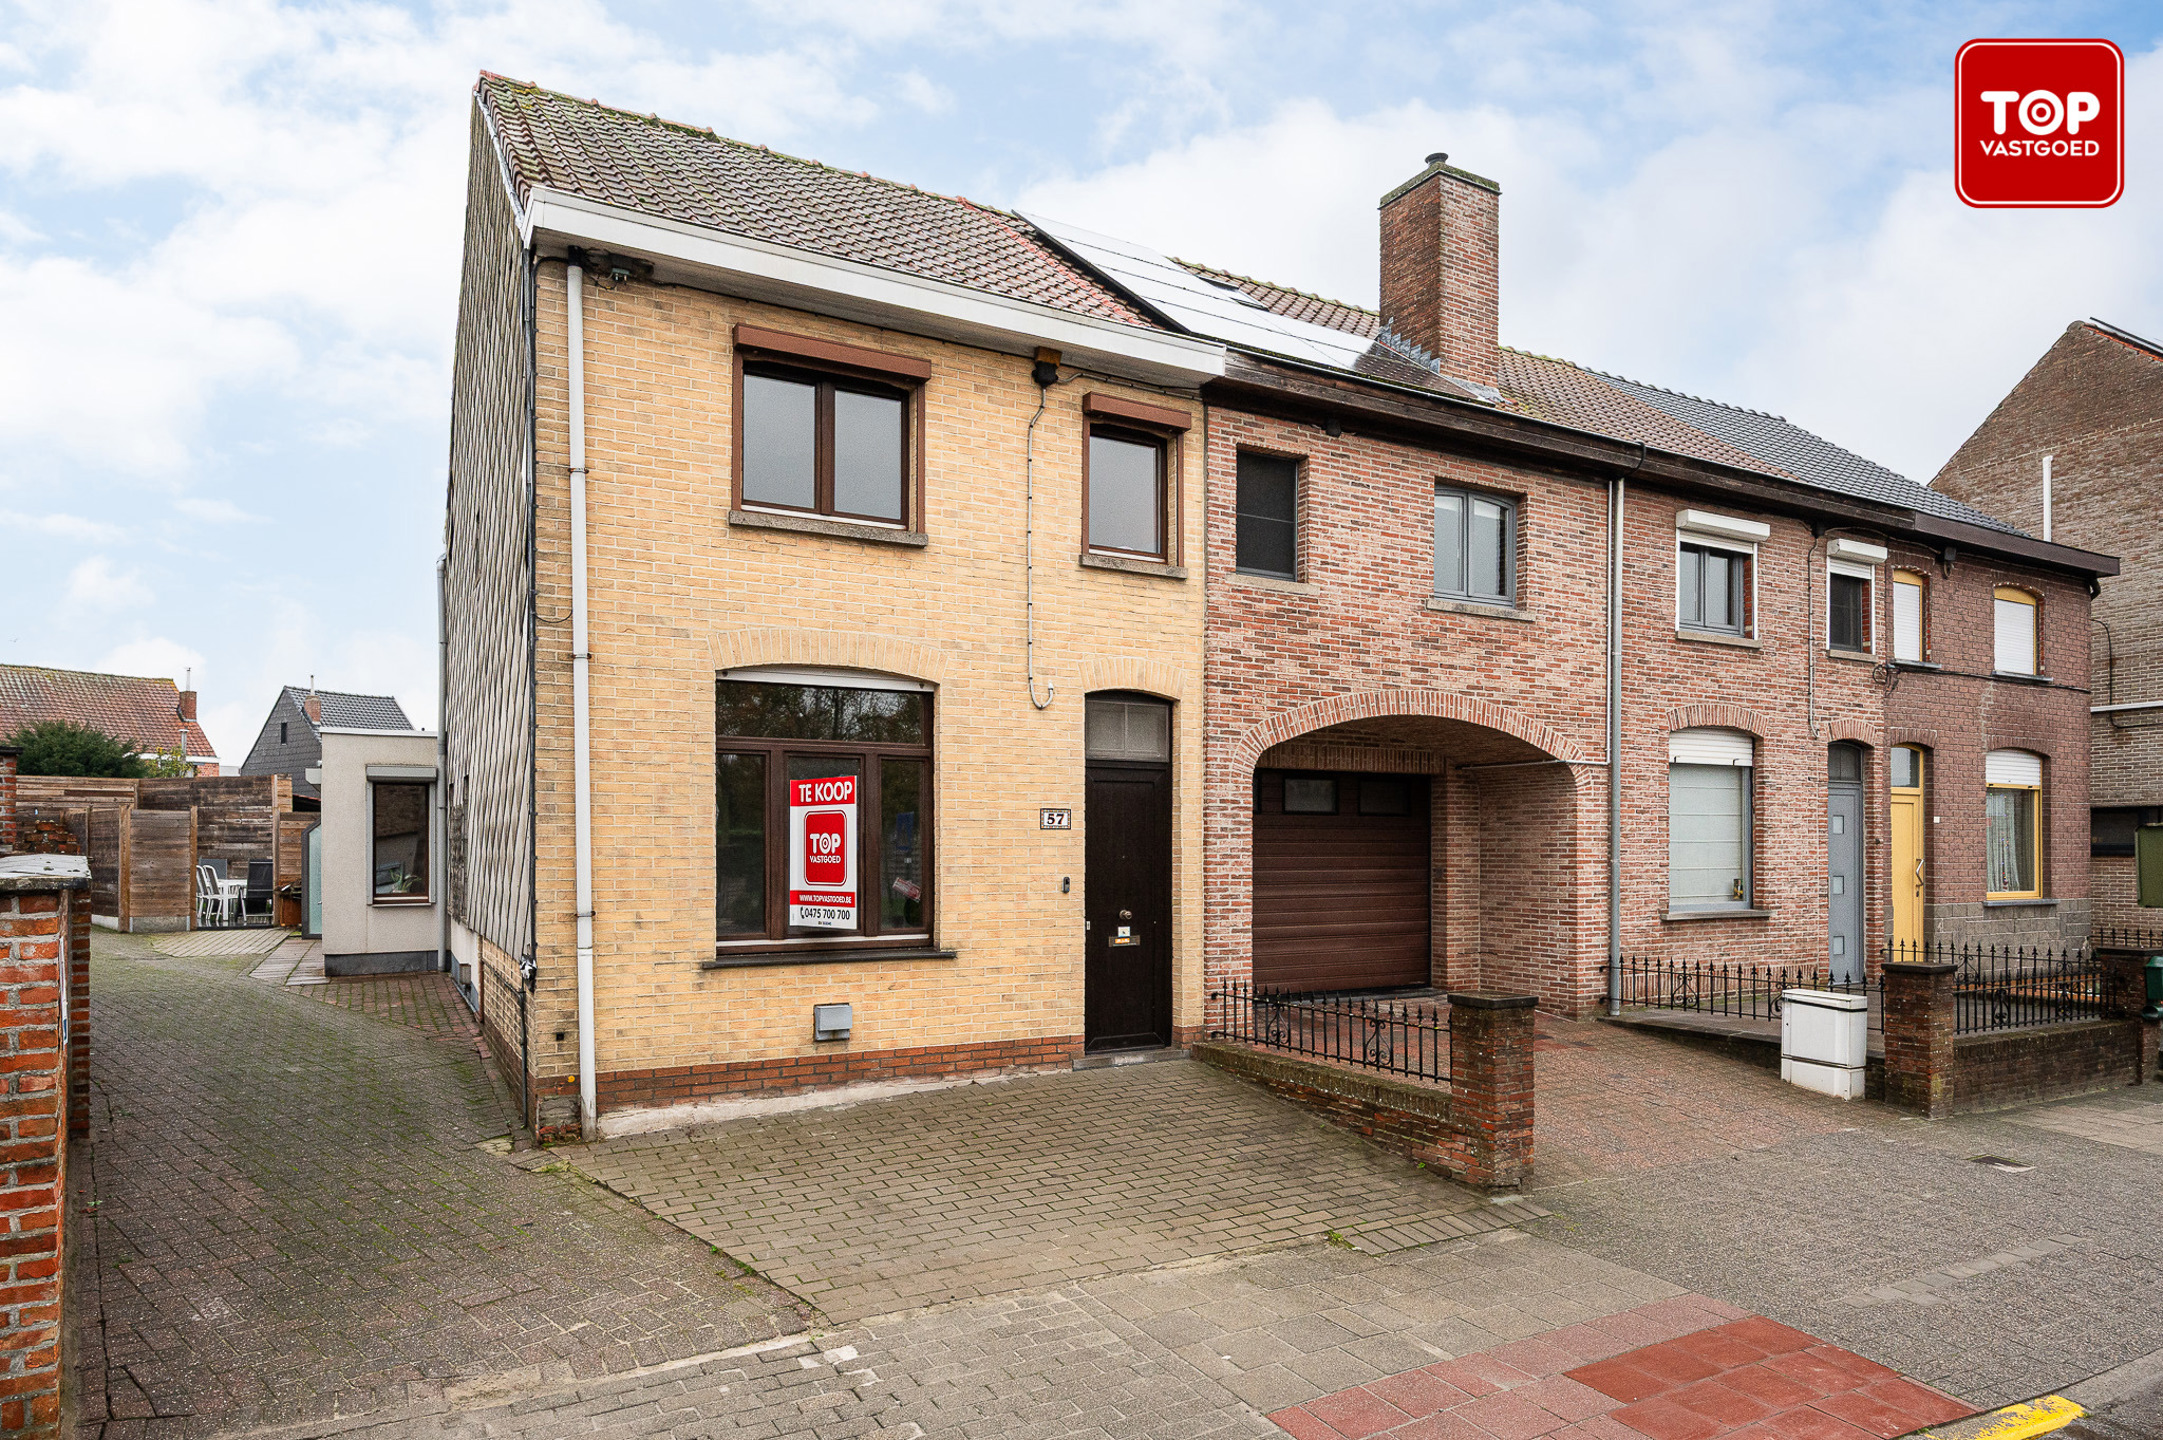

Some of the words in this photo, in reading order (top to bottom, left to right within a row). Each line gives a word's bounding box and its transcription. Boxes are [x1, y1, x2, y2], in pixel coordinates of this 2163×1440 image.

[799, 784, 812, 803] TE
[815, 781, 852, 802] KOOP
[1047, 813, 1064, 824] 57
[809, 832, 841, 854] TOP
[809, 855, 841, 864] VASTGOED
[804, 908, 821, 918] 0475
[822, 909, 836, 919] 700
[837, 909, 850, 920] 700
